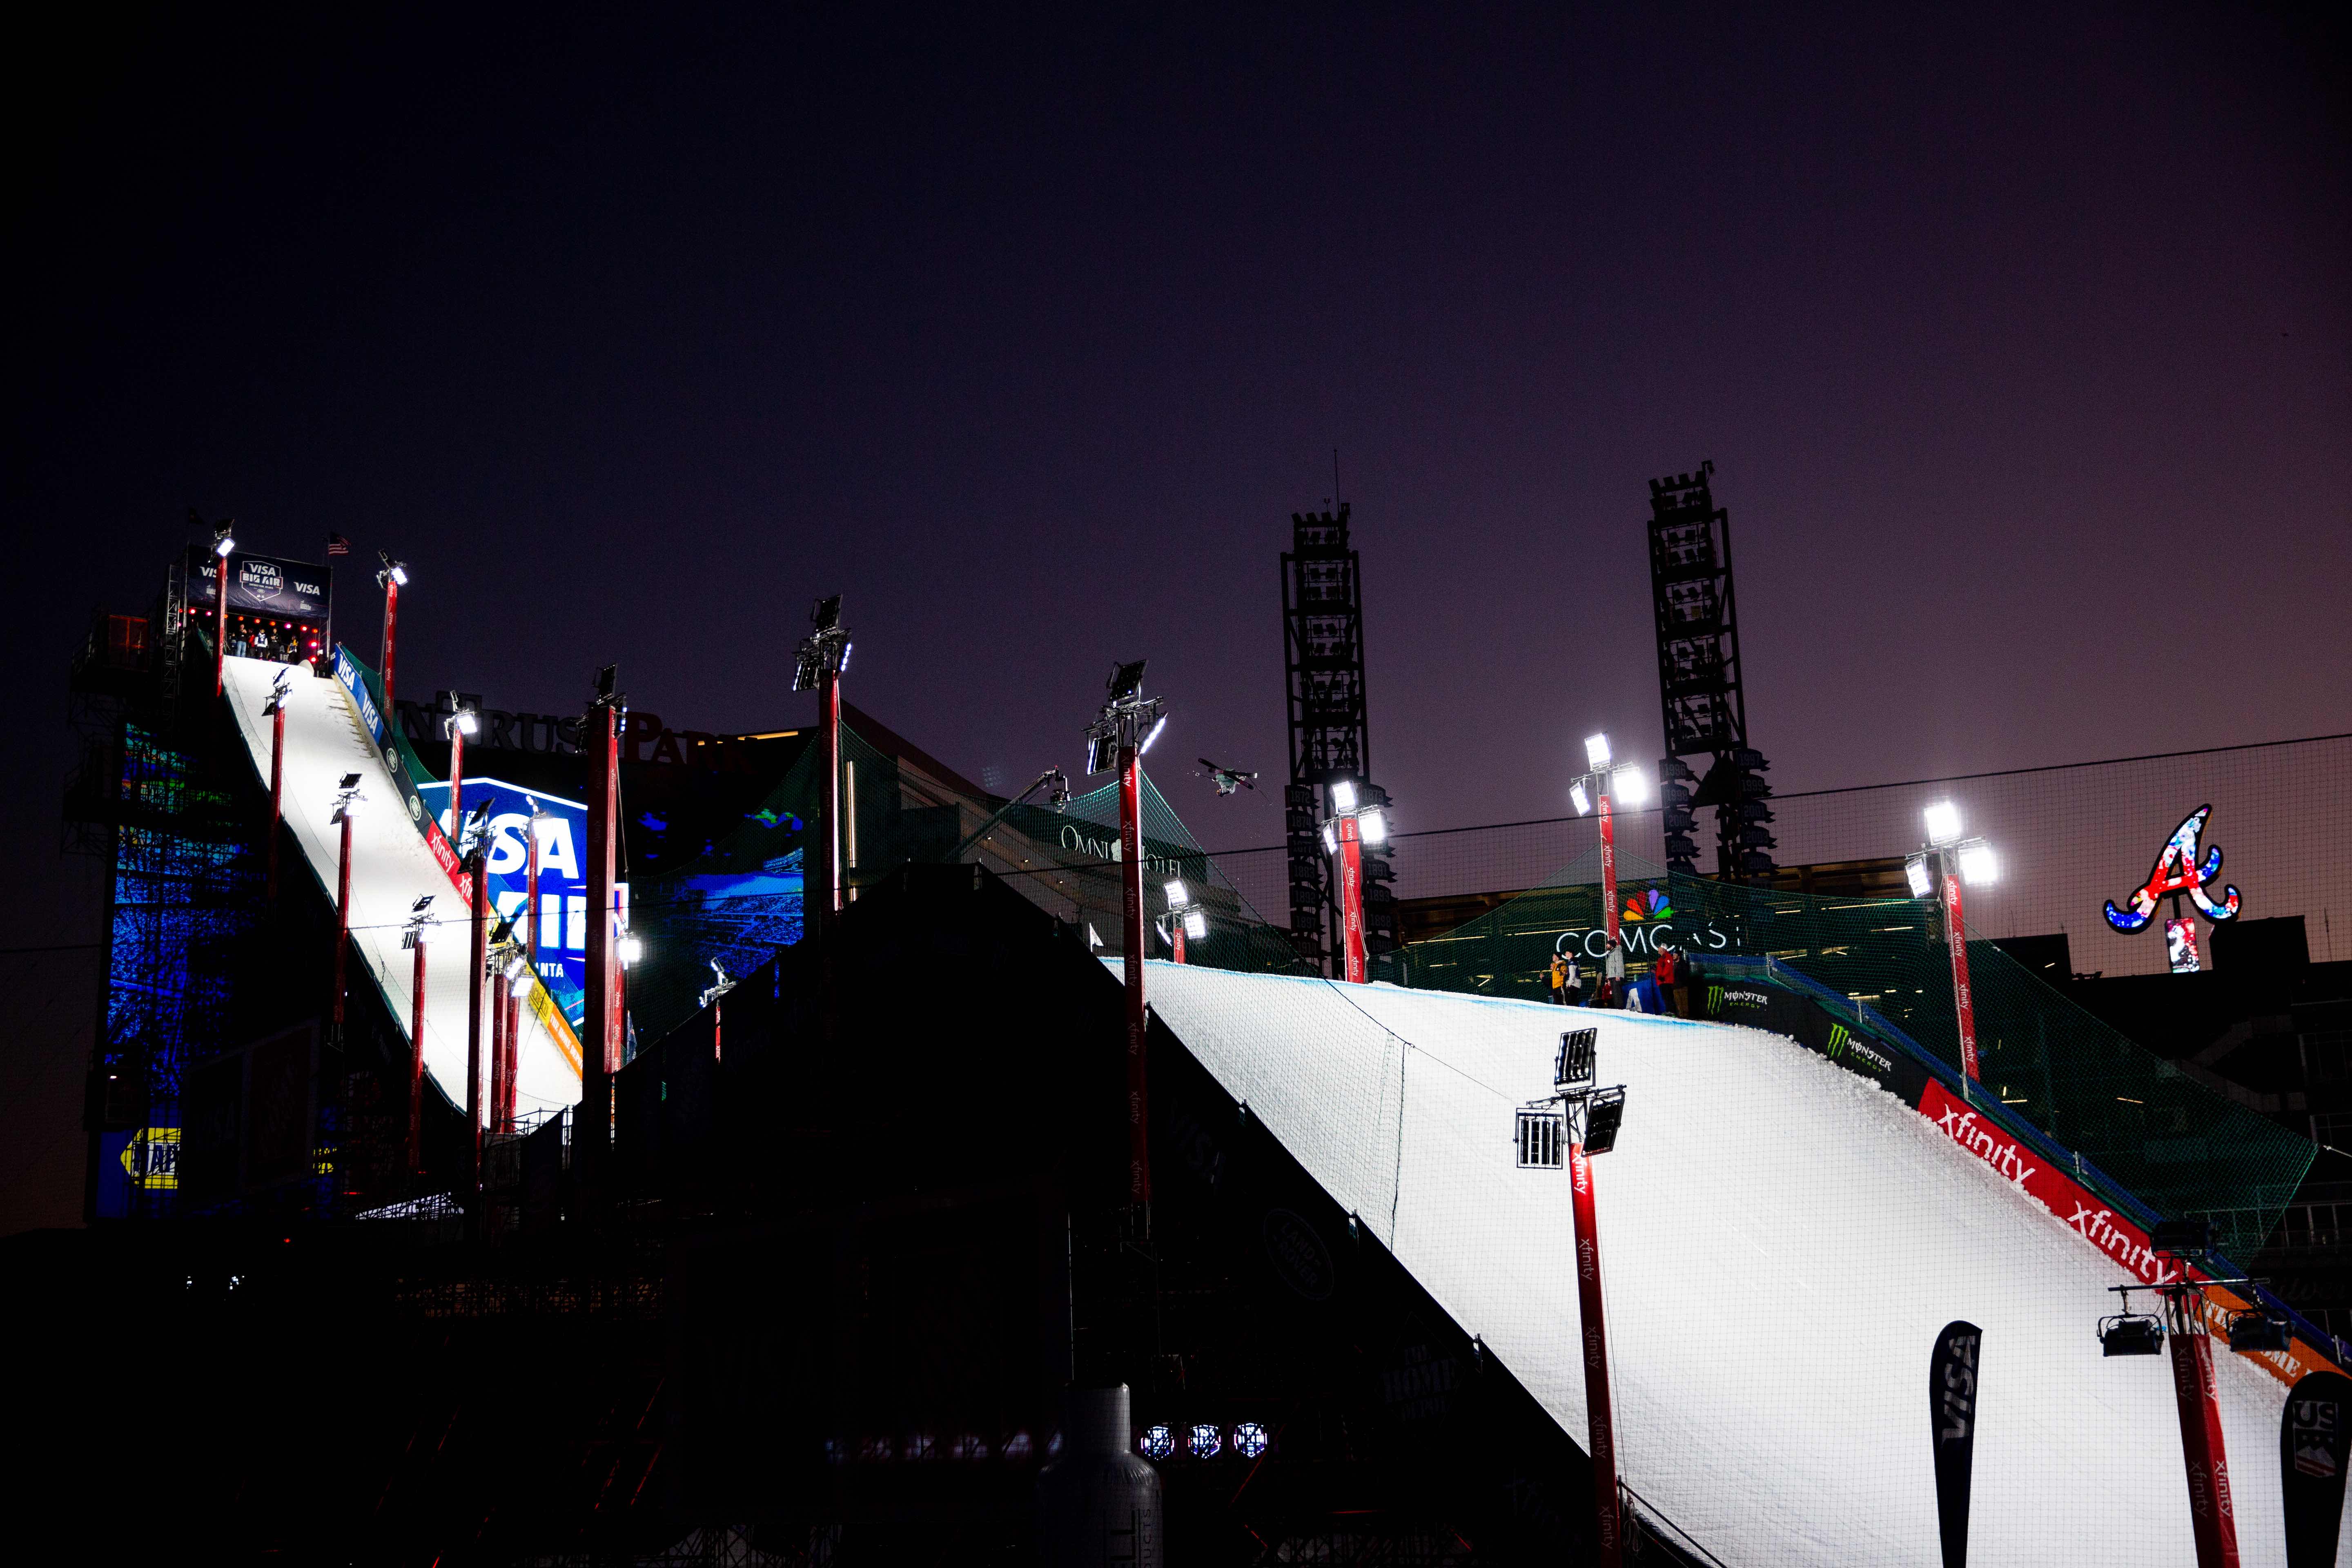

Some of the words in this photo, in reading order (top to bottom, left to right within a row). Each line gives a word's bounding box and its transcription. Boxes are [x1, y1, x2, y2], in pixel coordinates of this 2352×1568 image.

[243, 572, 260, 583] BIG
[262, 577, 280, 586] AIR
[248, 563, 276, 576] VISA
[293, 582, 320, 595] VISA
[339, 653, 354, 690] VISA
[362, 693, 379, 734] VISA
[1121, 755, 1131, 787] xfinity
[1742, 779, 1764, 792] 1999
[431, 832, 454, 873] xfinity
[1061, 825, 1109, 859] OMNI
[1123, 820, 1134, 853] xfinity
[1604, 845, 1612, 867] xfinity
[1125, 885, 1136, 920] xfinity
[1949, 880, 1958, 905] xfinity
[1953, 931, 1963, 957] xfinity
[1958, 984, 1968, 1010] xfinity
[1851, 1051, 1882, 1073] ENERGY
[1964, 1036, 1975, 1062] xfinity
[132, 1143, 180, 1173] NAP
[1937, 1103, 2036, 1183] xfinity
[1571, 1152, 1588, 1195] xfinity
[1579, 1238, 1593, 1281] xfinity
[2067, 1200, 2178, 1285] xfinity
[1585, 1326, 1601, 1369] xfinity
[1940, 1335, 1976, 1449] VISA
[2175, 1347, 2194, 1402] xfinity
[1591, 1414, 1608, 1459] xfinity
[2190, 1460, 2208, 1518] xfinity
[2216, 1459, 2231, 1517] xfinity
[1597, 1505, 1615, 1550] xfinity
